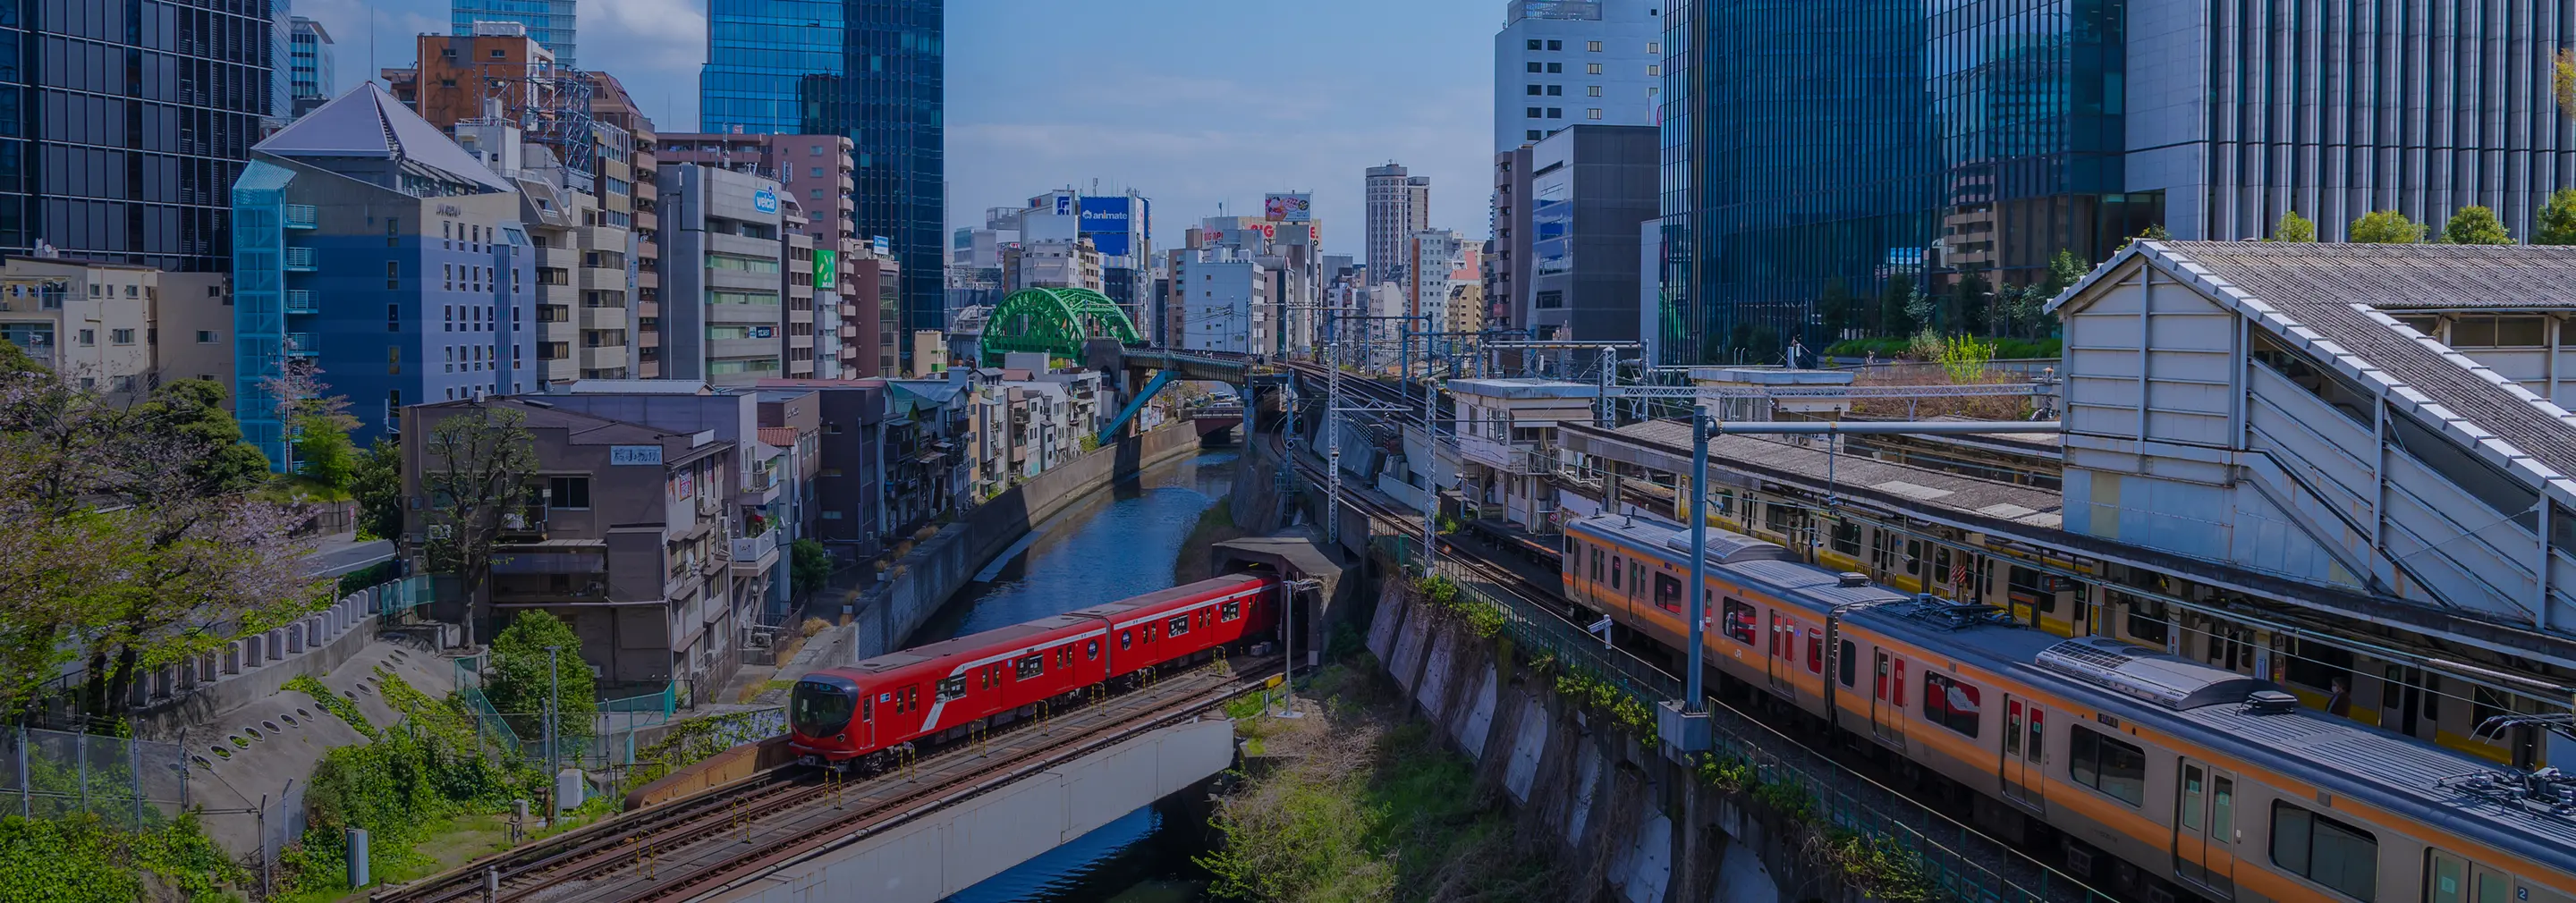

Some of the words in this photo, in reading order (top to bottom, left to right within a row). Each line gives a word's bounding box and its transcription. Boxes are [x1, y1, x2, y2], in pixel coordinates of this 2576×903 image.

[756, 193, 775, 210] welcia
[1092, 209, 1128, 220] animate
[1734, 649, 1742, 659] JR
[2520, 888, 2526, 899] 2
